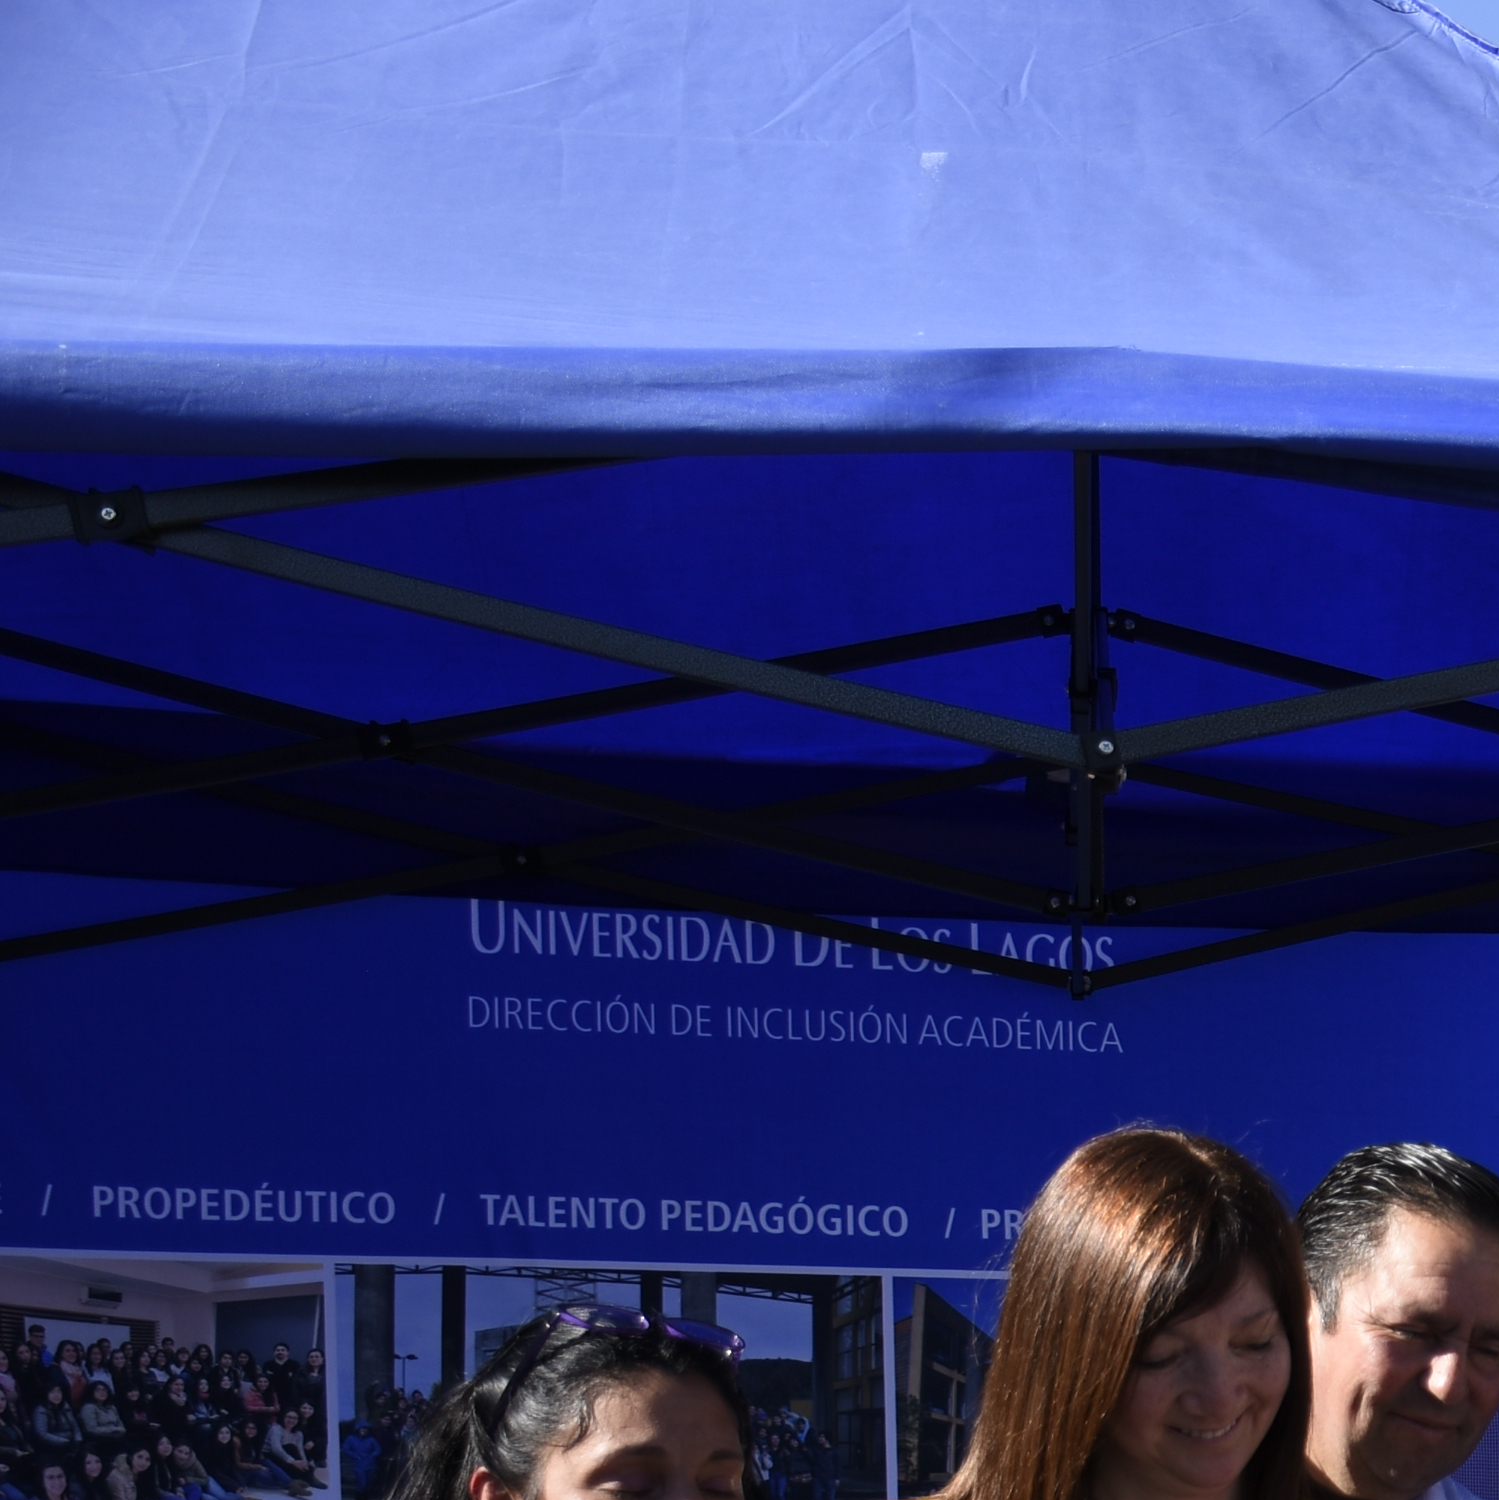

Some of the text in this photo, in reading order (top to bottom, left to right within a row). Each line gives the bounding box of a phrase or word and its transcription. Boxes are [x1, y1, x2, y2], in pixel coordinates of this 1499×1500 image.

[468, 898, 776, 966] UNIVERSIDAD
[467, 994, 1125, 1054] DIRECCIÓN DE INCLUSIÓN ACADÉMICA
[92, 1183, 396, 1224] PROPEDÉUTICO
[480, 1193, 646, 1231] TALENTO
[660, 1195, 910, 1238] PEDAGÓGICO
